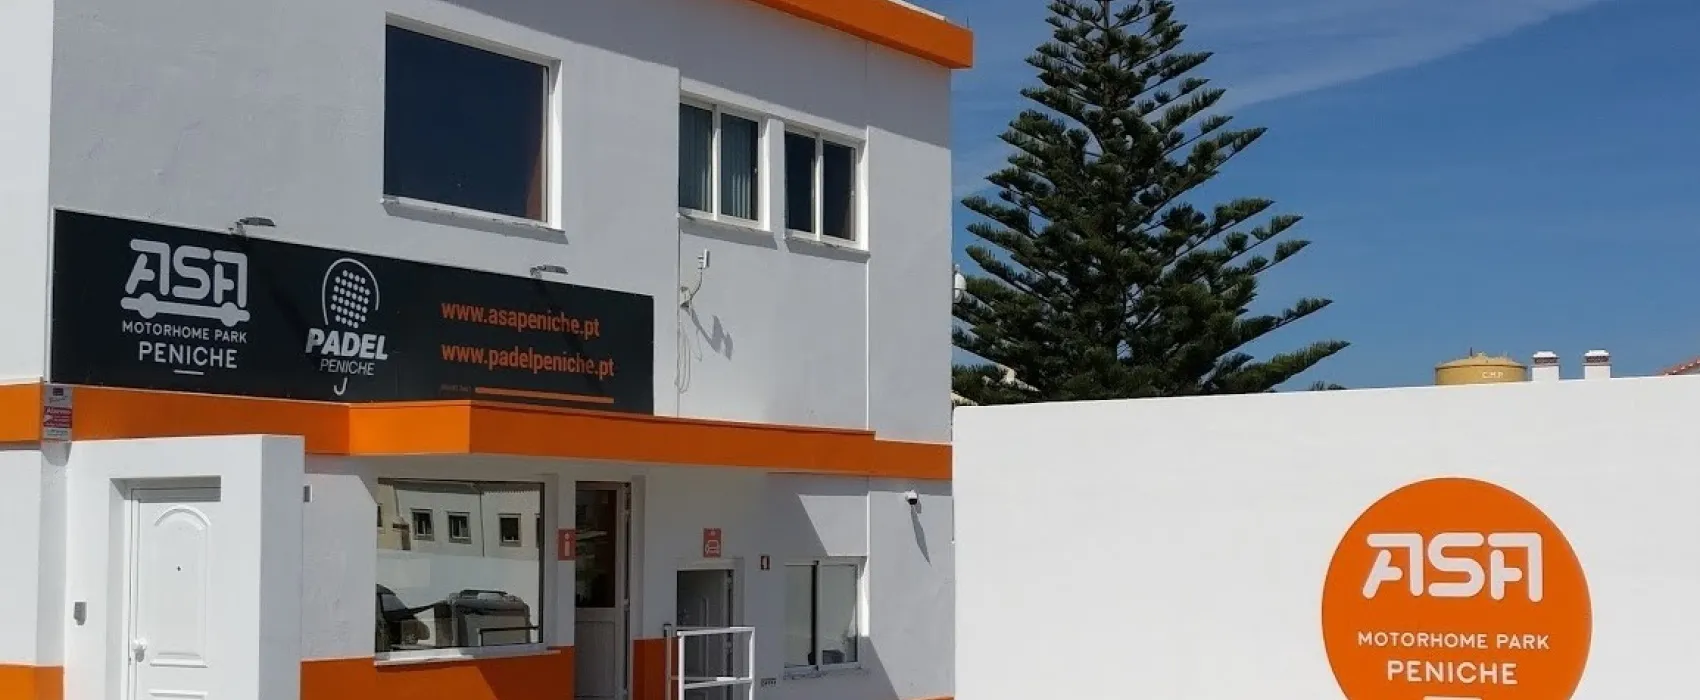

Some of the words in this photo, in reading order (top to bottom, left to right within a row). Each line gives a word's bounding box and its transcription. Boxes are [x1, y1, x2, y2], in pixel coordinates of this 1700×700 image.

[124, 238, 249, 309] ASA
[121, 319, 210, 341] MOTORHOME
[214, 329, 248, 344] PARK
[440, 302, 601, 340] www.asapeniche.pt
[138, 340, 238, 370] PENICHE
[305, 327, 389, 361] PADEL
[319, 358, 375, 376] PENICHE
[440, 343, 615, 380] www.padelpeniche.pt
[1362, 532, 1544, 602] ASA
[1357, 631, 1489, 649] MOTORHOME
[1496, 633, 1550, 650] PARK
[1387, 660, 1518, 685] PENICHE
